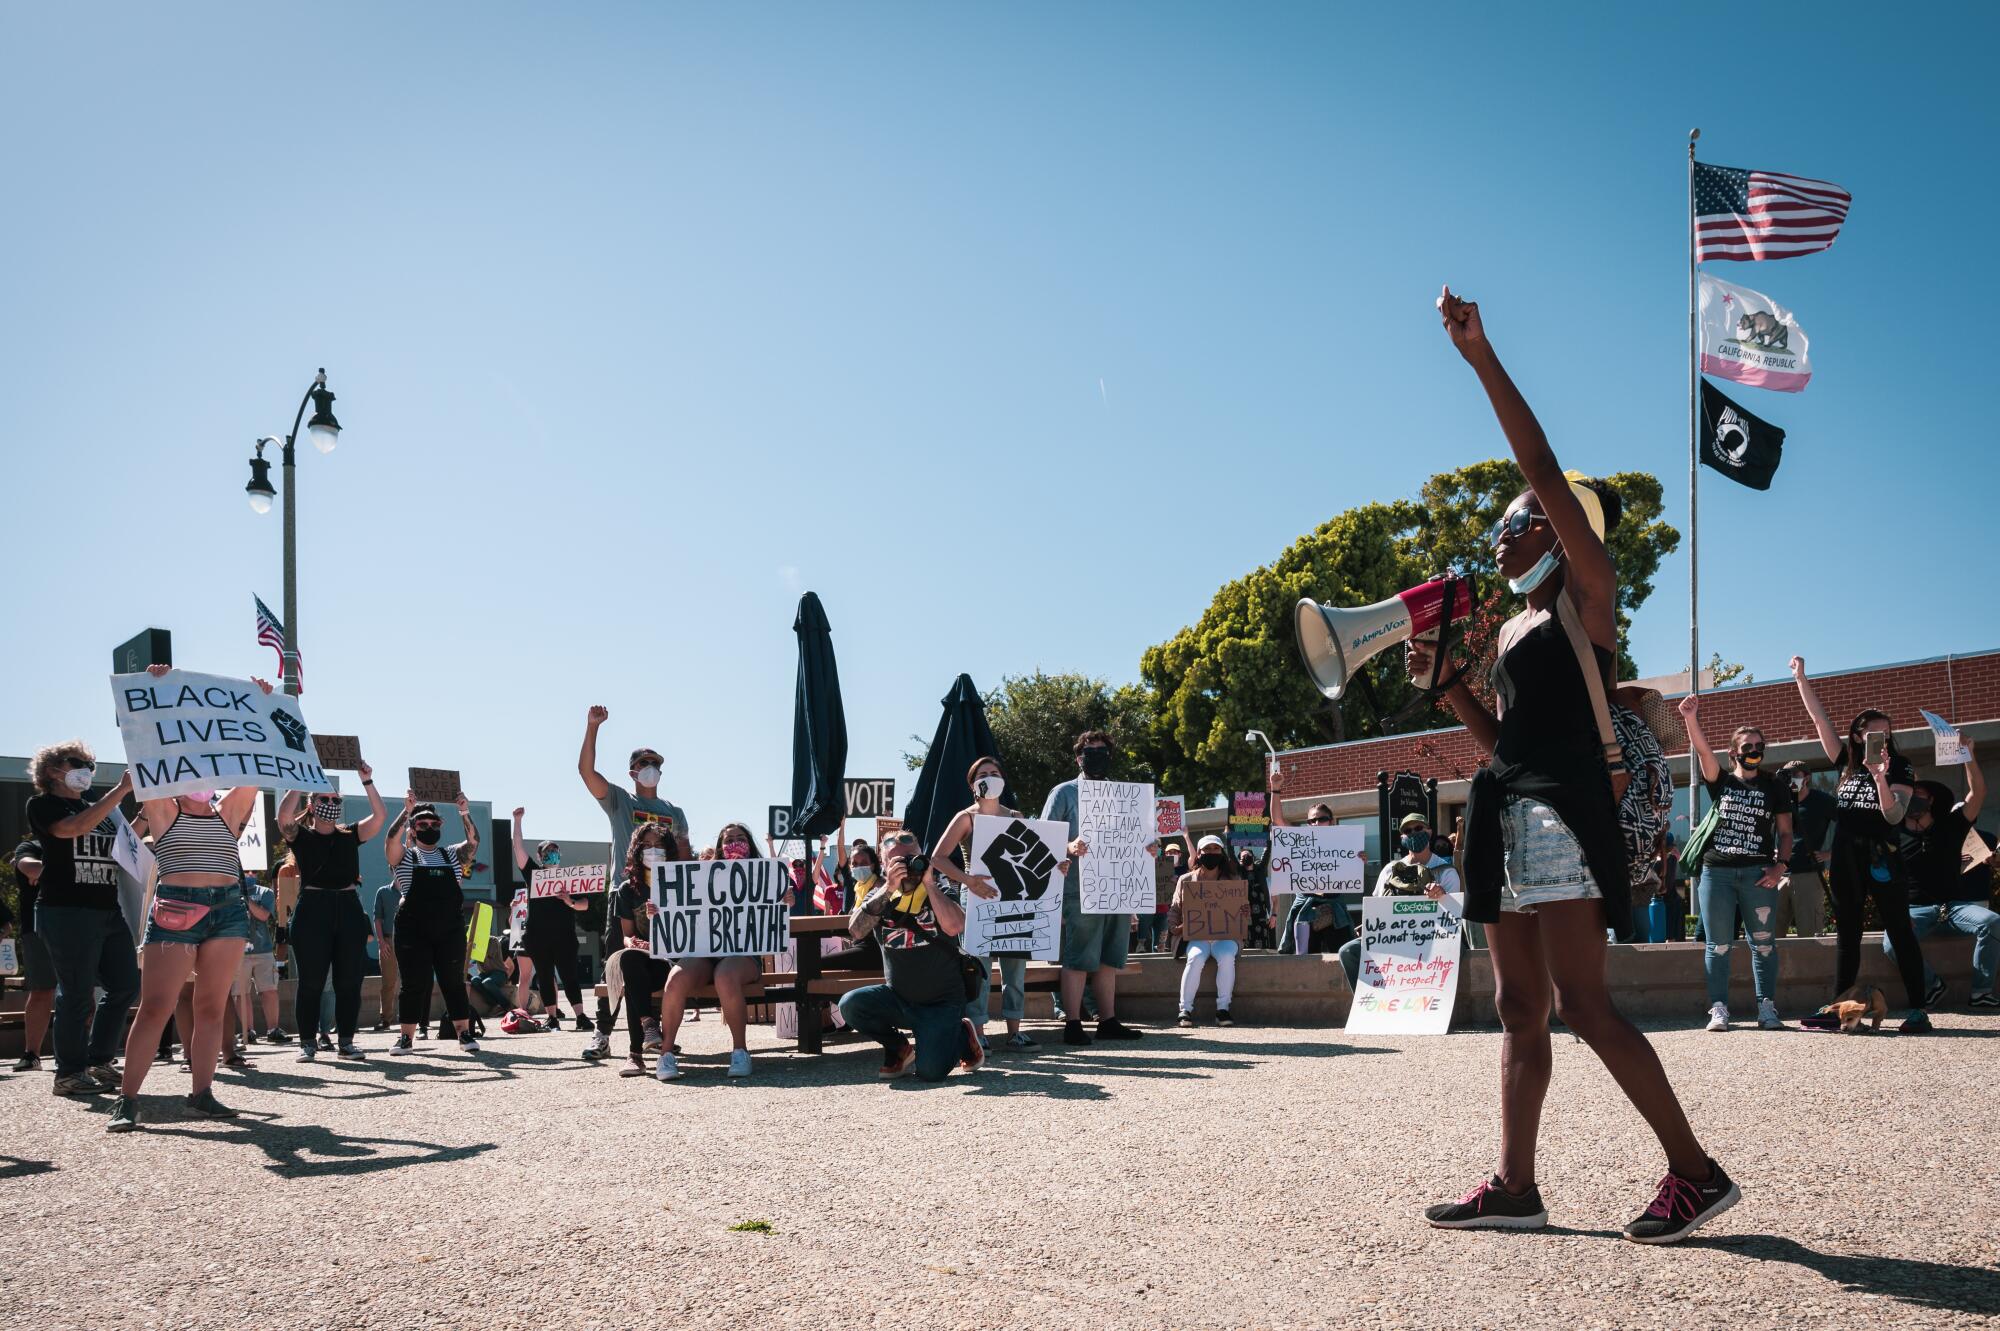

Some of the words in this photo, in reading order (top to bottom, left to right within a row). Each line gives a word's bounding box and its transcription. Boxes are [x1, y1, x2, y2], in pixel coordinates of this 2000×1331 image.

[1718, 345, 1761, 363] CALIFORNIA
[1764, 356, 1797, 369] REPUBLIC
[124, 685, 257, 714] BLACK
[155, 719, 267, 746] LIVES
[317, 735, 356, 747] LACK
[319, 746, 357, 758] IVES
[135, 753, 328, 788] MATTER!!!
[322, 758, 359, 769] TTER
[1081, 780, 1141, 799] AHMAUD
[1748, 790, 1765, 798] are
[844, 781, 895, 816] VOTE
[1081, 799, 1139, 814] TAMIR
[1754, 797, 1764, 806] in
[1081, 814, 1142, 832] ATATIANA
[1731, 820, 1755, 832] have
[1082, 829, 1146, 844] STEPHON
[1713, 835, 1731, 844] side
[1743, 840, 1759, 849] the
[1747, 833, 1763, 843] the
[1082, 844, 1145, 860] ANTWON
[1290, 847, 1355, 860] Existance
[535, 866, 586, 880] SILENCE
[590, 865, 603, 876] IS
[1082, 860, 1146, 878] ALTON
[1271, 857, 1293, 872] OR
[1301, 860, 1340, 875] Expect
[536, 878, 605, 896] VIOLENCE
[658, 864, 702, 907] HE
[708, 861, 789, 905] COULD
[1083, 876, 1150, 892] BOTHAM
[987, 901, 1043, 916] BLACK
[1082, 892, 1155, 911] GEORGE
[652, 909, 701, 955] NOT
[708, 905, 788, 953] BREATHE
[994, 922, 1035, 935] LIVES
[1187, 909, 1244, 936] BLM
[1365, 918, 1386, 932] We
[1391, 918, 1416, 929] are
[1421, 919, 1435, 927] on
[1437, 911, 1461, 927] this
[990, 939, 1041, 950] MATTER
[1366, 930, 1408, 951] planet
[1410, 925, 1459, 946] together!
[1364, 957, 1392, 975] Treat
[1397, 953, 1422, 972] each
[1427, 956, 1454, 970] other
[1373, 974, 1395, 987] with
[1358, 993, 1400, 1012] #ONE
[1402, 995, 1440, 1012] LOVE
